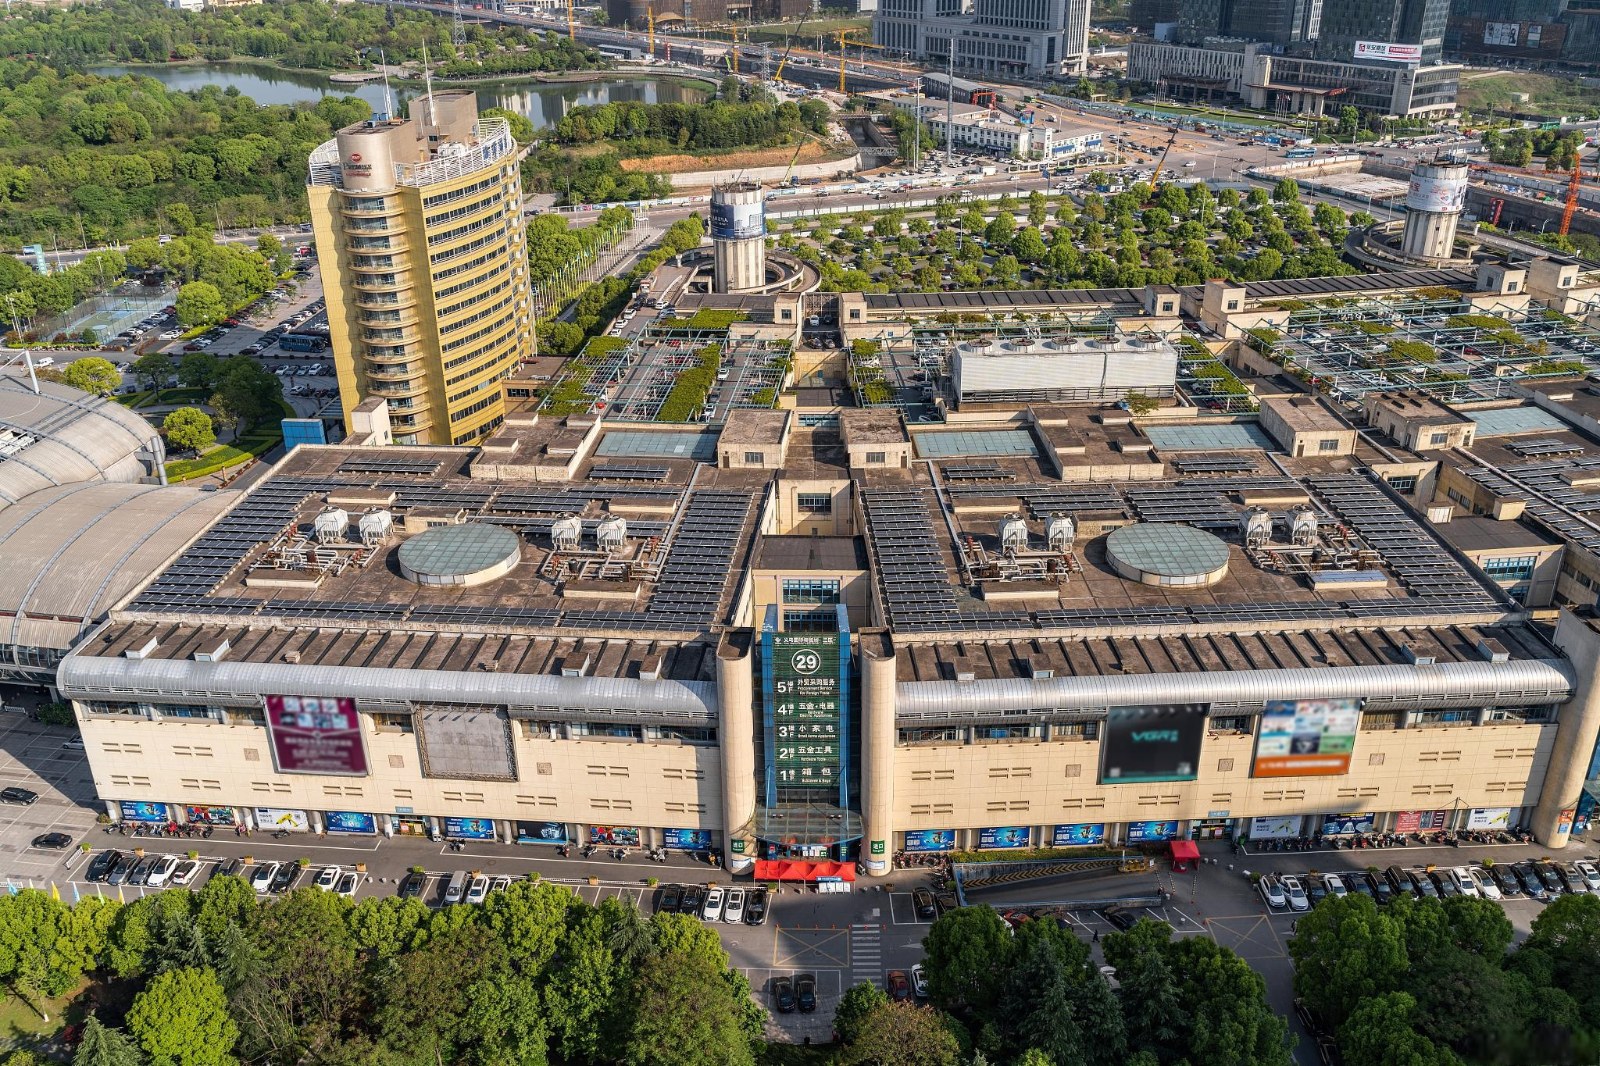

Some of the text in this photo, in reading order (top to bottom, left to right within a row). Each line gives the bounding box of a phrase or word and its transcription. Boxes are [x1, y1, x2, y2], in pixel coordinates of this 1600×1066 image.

[796, 655, 817, 669] 29
[777, 681, 787, 693] 5
[777, 704, 788, 715] 4
[778, 726, 788, 737] 3
[779, 747, 789, 759] 2
[797, 745, 833, 754] 五金工具
[780, 769, 787, 781] 1
